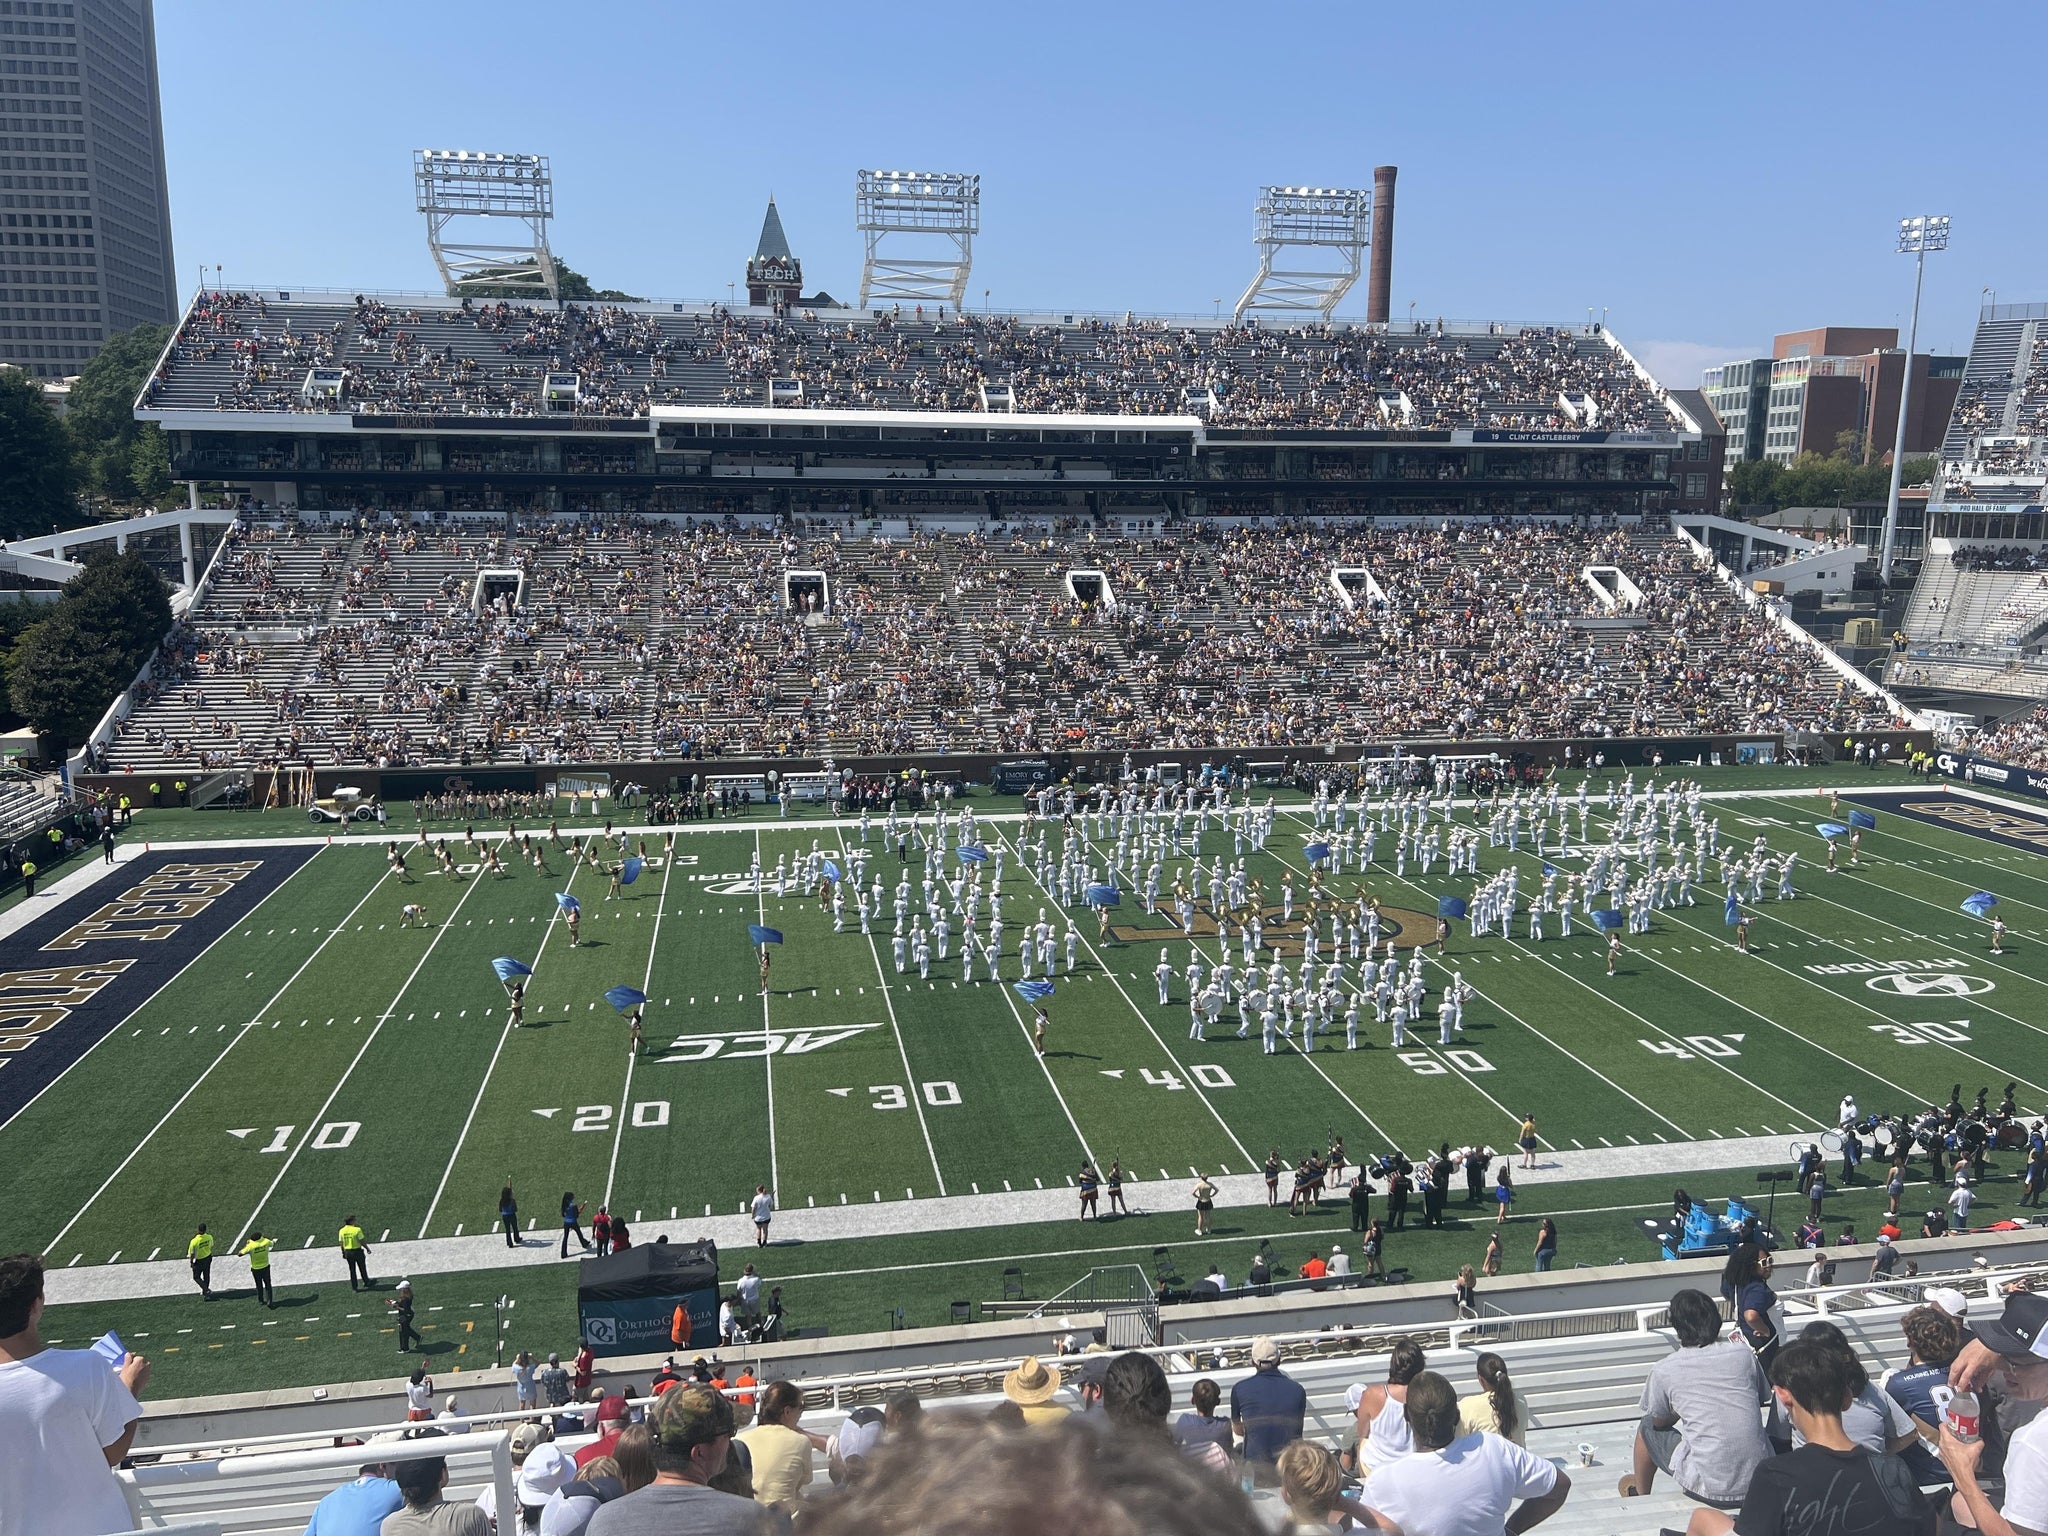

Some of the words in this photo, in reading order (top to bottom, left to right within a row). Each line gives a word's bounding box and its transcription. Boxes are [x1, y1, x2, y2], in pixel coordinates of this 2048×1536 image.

[395, 416, 436, 429] JACKETS
[571, 418, 611, 431] JACKETS
[1240, 430, 1275, 441] JACKETS
[1491, 433, 1500, 441] 19
[1508, 433, 1531, 441] CLINT
[1531, 434, 1581, 442] CASTLEBERRY
[1960, 504, 1971, 512] PRO
[1971, 504, 1985, 512] HALL
[1985, 504, 1993, 512] OF
[1993, 504, 2007, 512] FAME
[559, 777, 588, 791] STING
[38, 860, 264, 951] TECH
[1803, 957, 1970, 975] HYUNDAI
[653, 1024, 880, 1063] ACC
[1867, 1022, 1973, 1045] 30
[1637, 1035, 1742, 1059] 40
[1396, 1050, 1498, 1076] 50
[1138, 1063, 1237, 1091] 40
[868, 1080, 963, 1110] 30
[571, 1100, 671, 1132] 20
[259, 1121, 362, 1154] 10
[1903, 1370, 1930, 1382] HOUSING
[1928, 1368, 1941, 1377] AND
